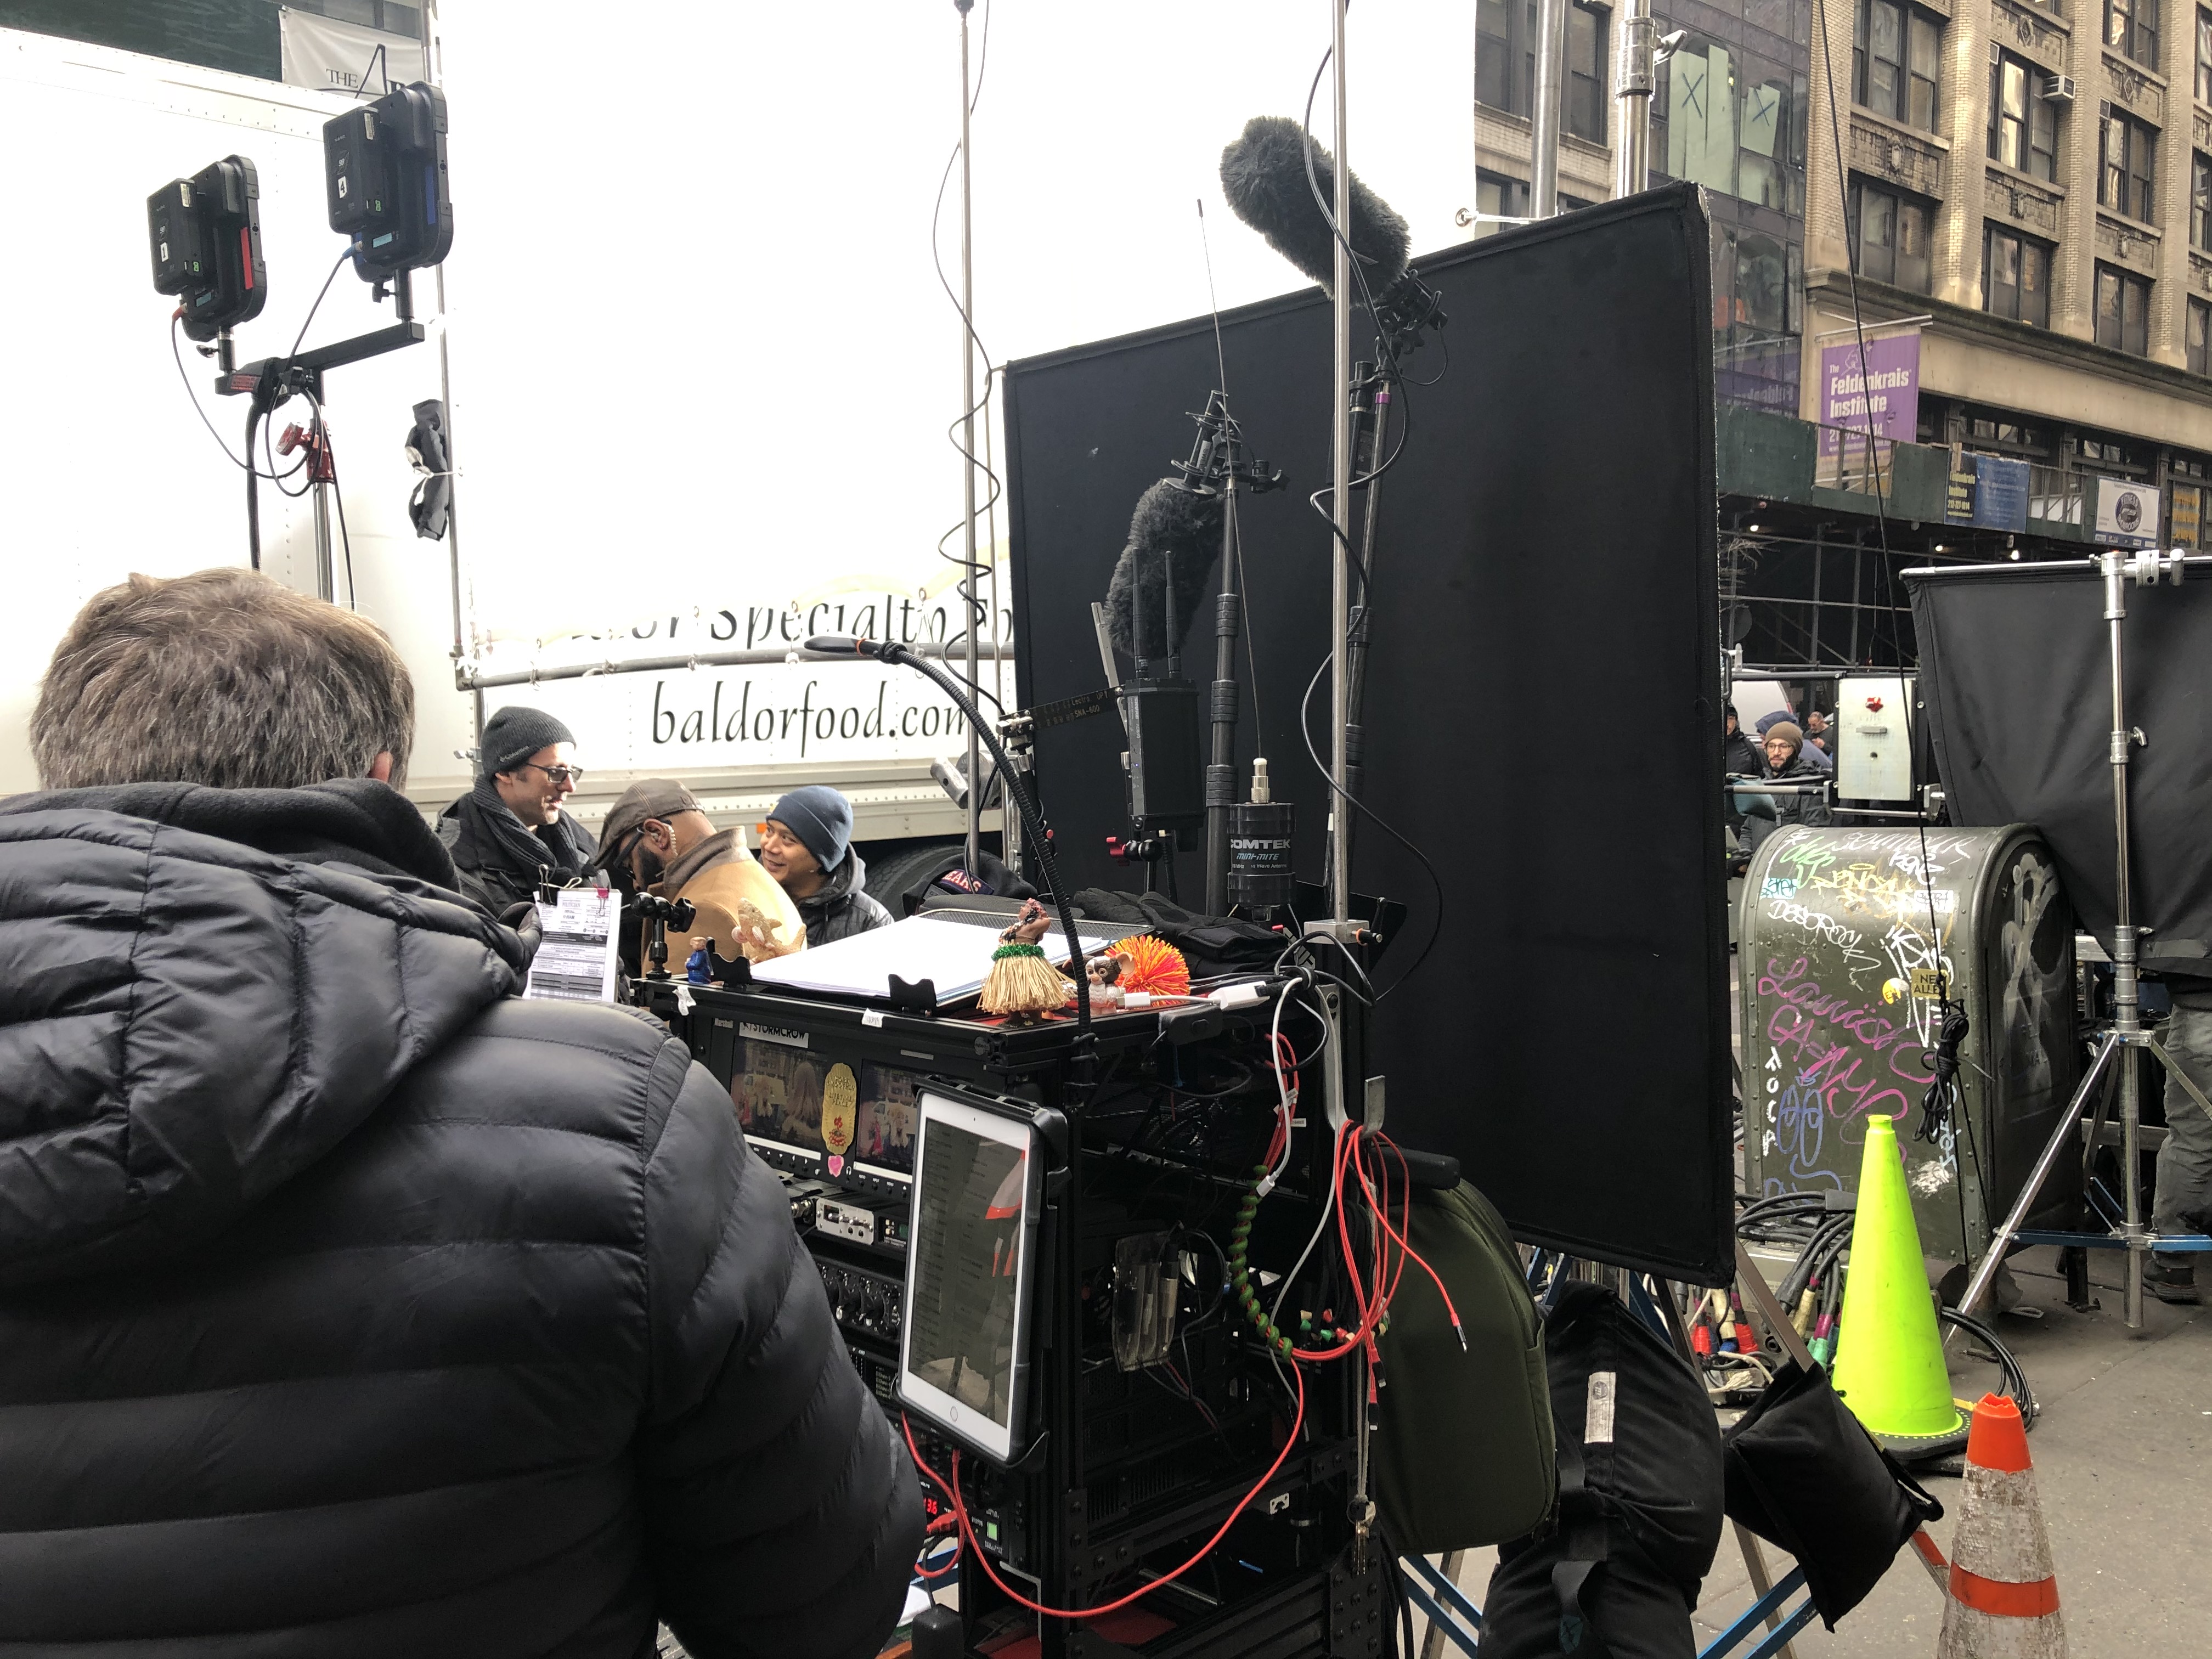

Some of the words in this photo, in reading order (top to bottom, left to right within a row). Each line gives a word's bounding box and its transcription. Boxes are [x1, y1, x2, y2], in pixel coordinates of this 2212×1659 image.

[326, 68, 358, 88] THE
[340, 180, 346, 194] 4
[162, 247, 166, 258] 1
[1830, 364, 1839, 374] The
[1830, 368, 1910, 396] Feldenkrais
